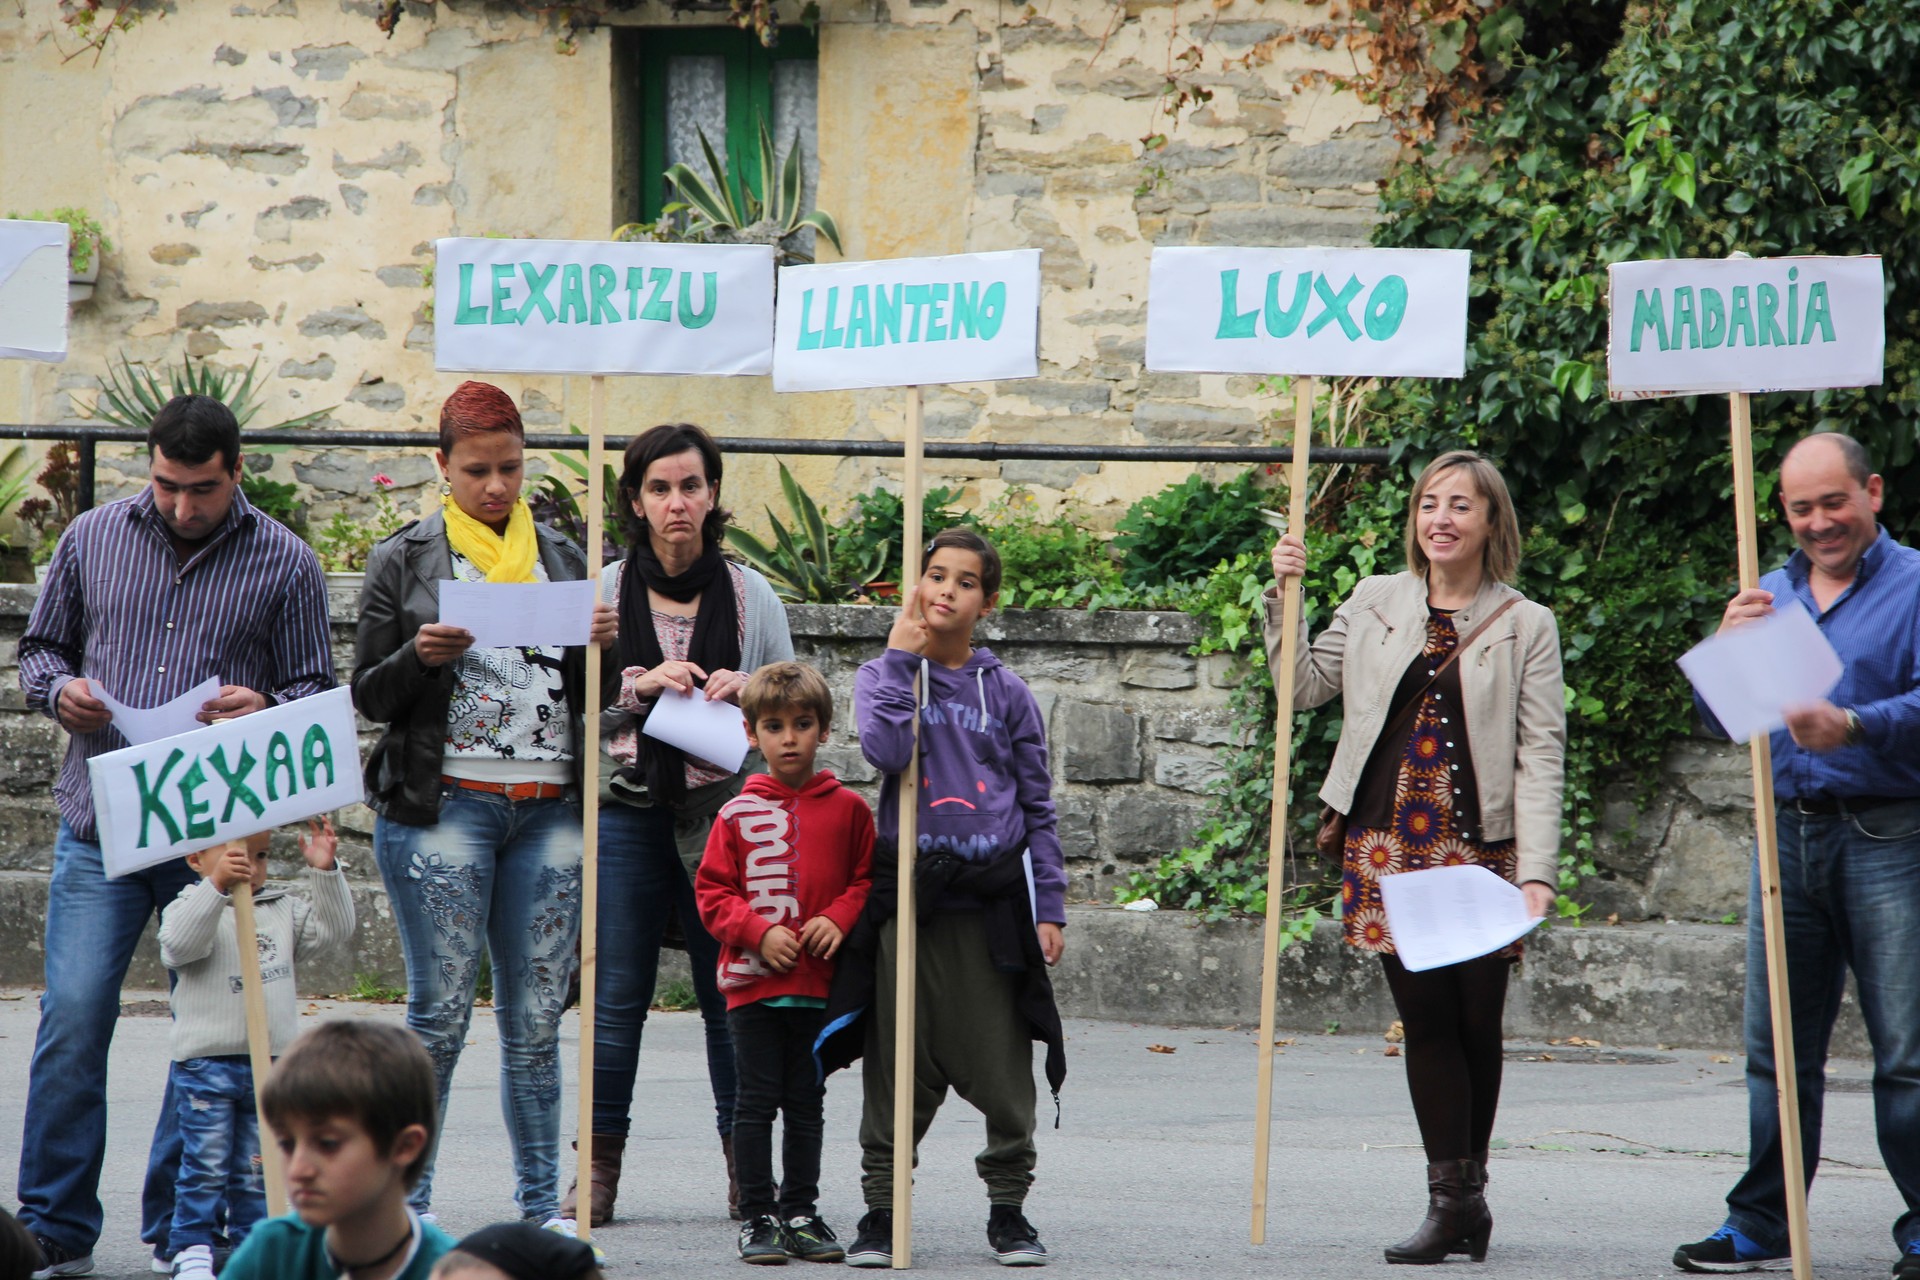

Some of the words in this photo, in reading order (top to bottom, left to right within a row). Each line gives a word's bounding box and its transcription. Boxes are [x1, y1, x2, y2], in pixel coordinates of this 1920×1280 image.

[454, 262, 718, 330] LEXARIZU
[797, 280, 1006, 351] LLANTENO
[1215, 268, 1409, 342] LUXO
[130, 723, 335, 849] KEXAA
